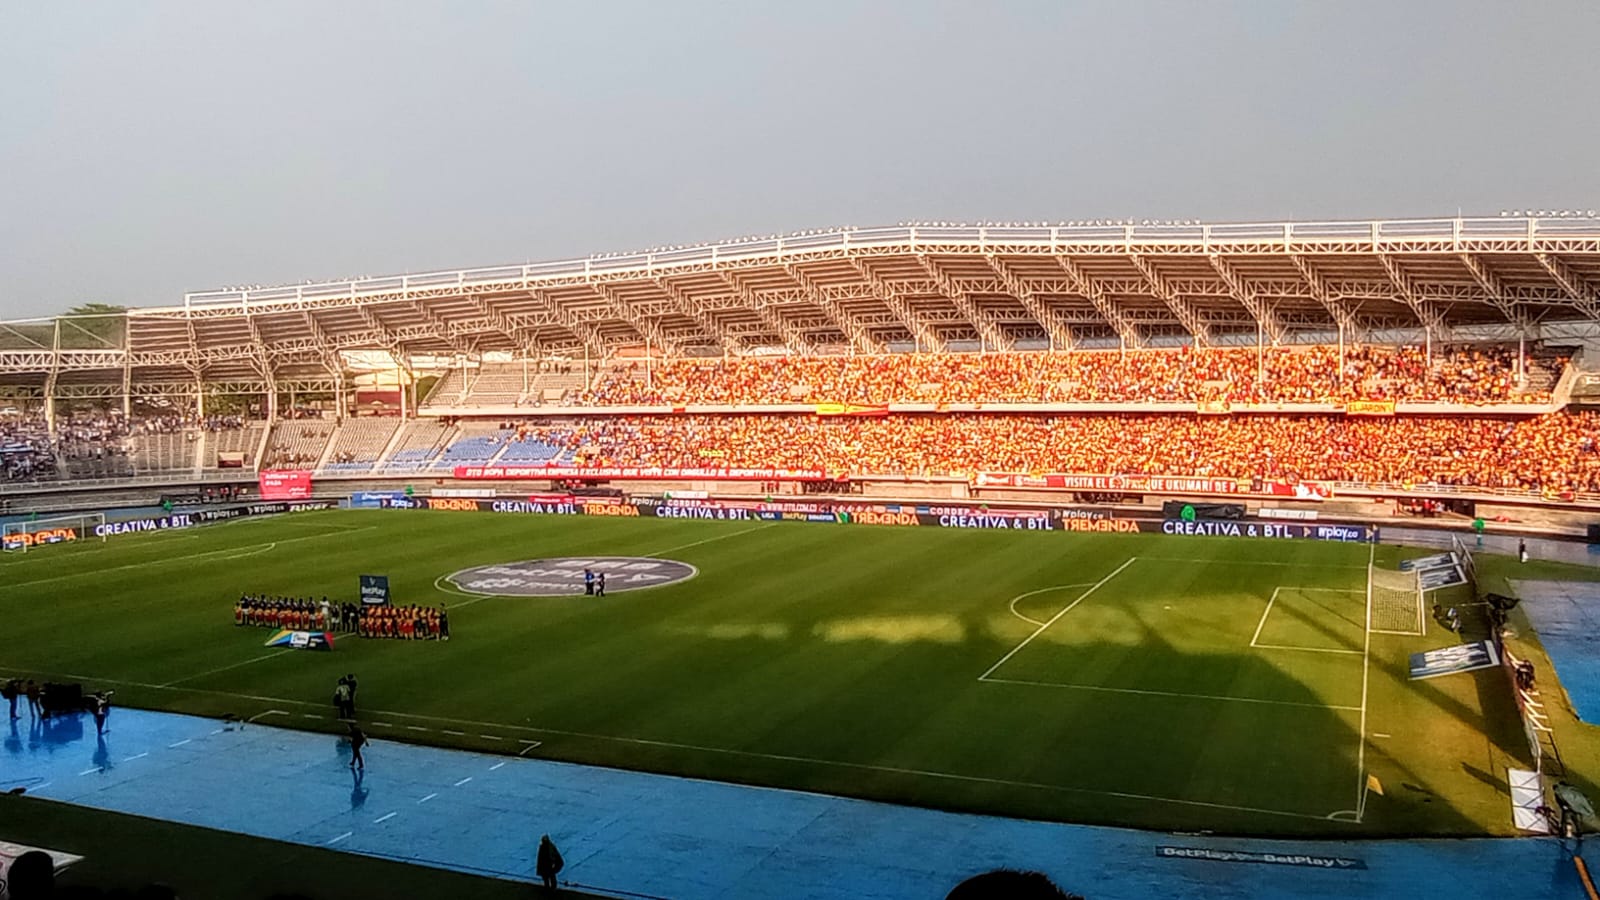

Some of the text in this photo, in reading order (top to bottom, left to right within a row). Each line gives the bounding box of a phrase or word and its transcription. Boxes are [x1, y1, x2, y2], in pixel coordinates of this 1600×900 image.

[483, 467, 504, 477] ROPA
[505, 467, 547, 477] DEPORTIVA
[579, 467, 621, 477] EXCLUSIVA
[622, 467, 638, 477] QUE
[663, 467, 679, 477] CON
[680, 467, 717, 477] ORGULLO
[728, 468, 775, 477] DEPORTIVO
[1064, 476, 1094, 489] VISITA
[1095, 477, 1107, 489] EL
[1214, 480, 1228, 493] DE
[492, 502, 576, 514] CREATIVA & BTL
[656, 507, 751, 520] CREATIVA & BTL
[96, 514, 193, 537] CREATIVA & BTL
[939, 515, 1053, 530] CREATIVA & BTL
[1163, 521, 1293, 538] CREATIVA & BTL
[1163, 847, 1334, 868] BetPlay BetPlay
